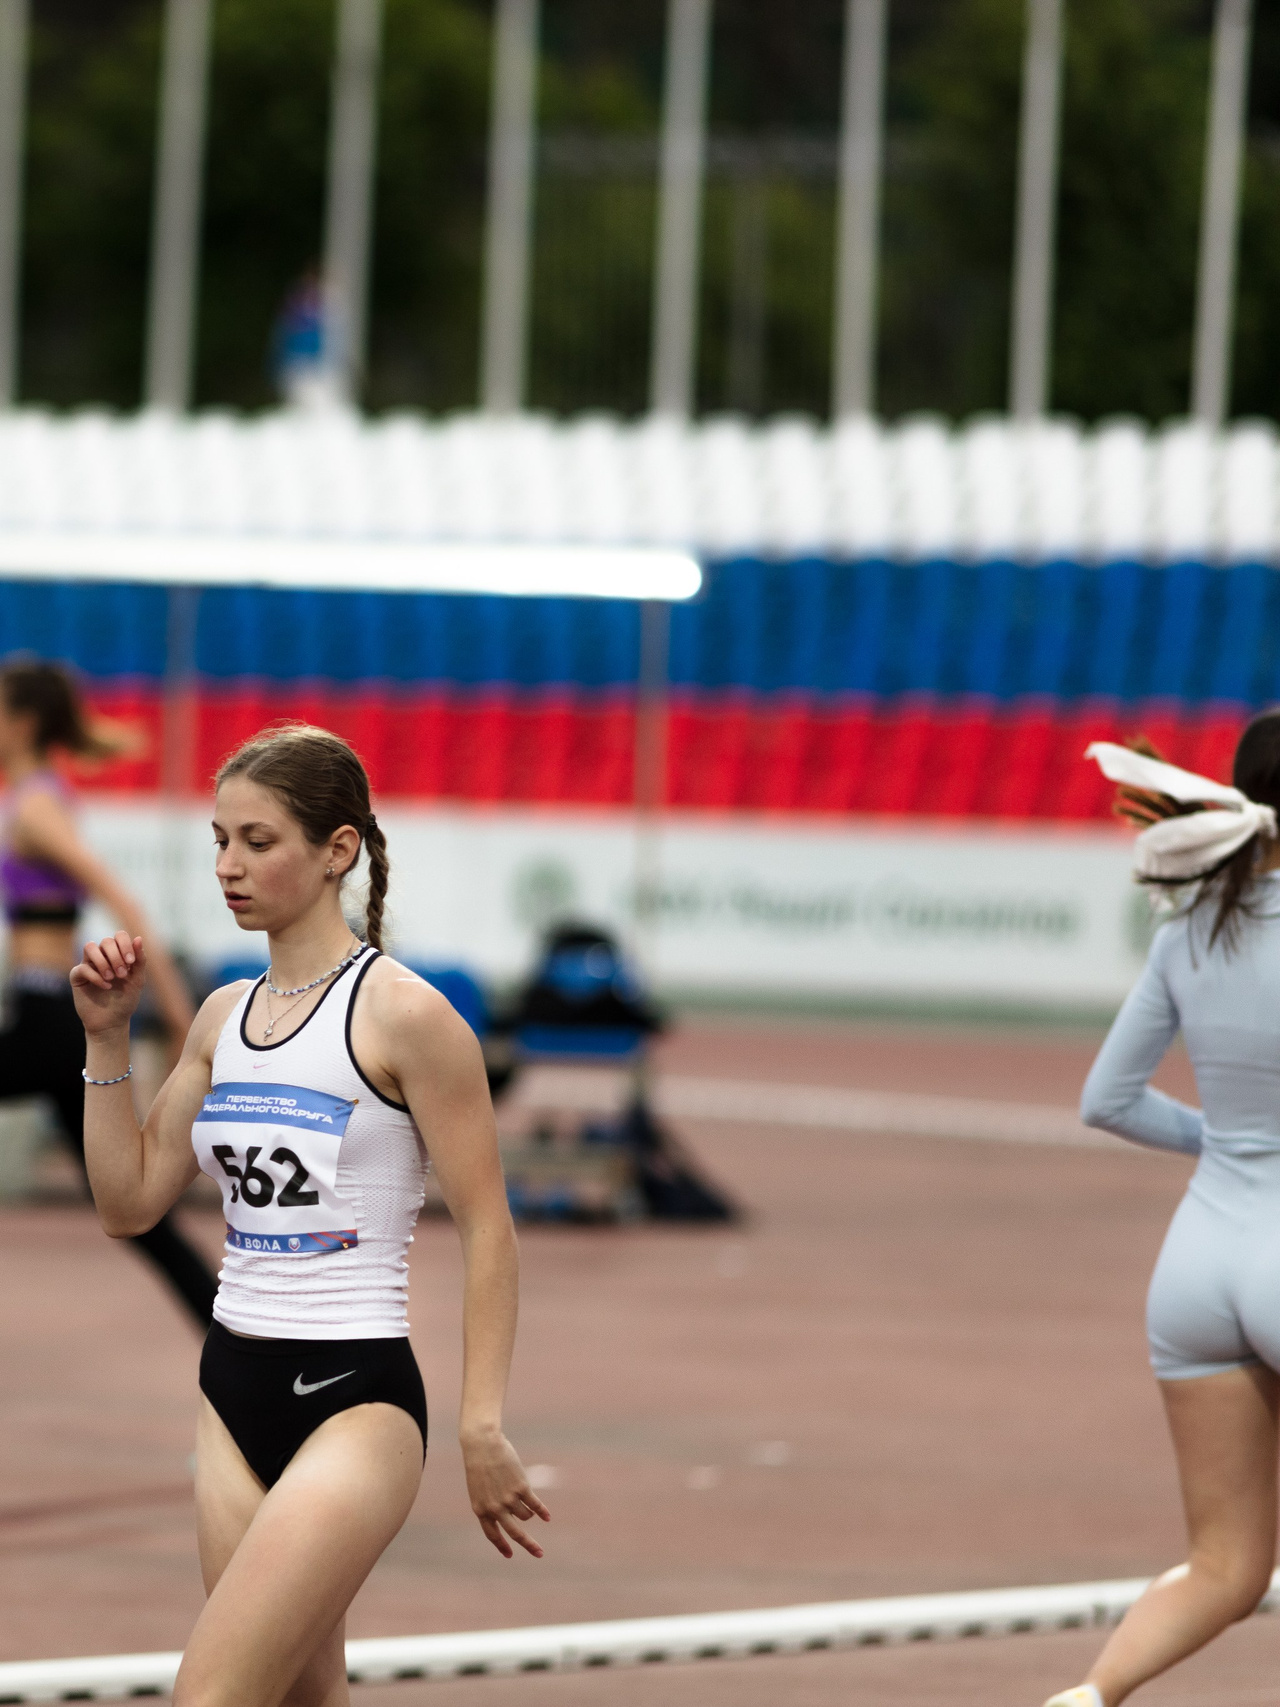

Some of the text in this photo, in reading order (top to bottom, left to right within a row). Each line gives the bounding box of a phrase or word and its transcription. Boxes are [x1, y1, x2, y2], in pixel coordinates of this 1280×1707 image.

[226, 1095, 297, 1107] ПЕРВЕНСТВО
[280, 1107, 334, 1124] ОКРУГА
[212, 1145, 320, 1208] 562
[244, 1237, 282, 1251] ВФЛА
